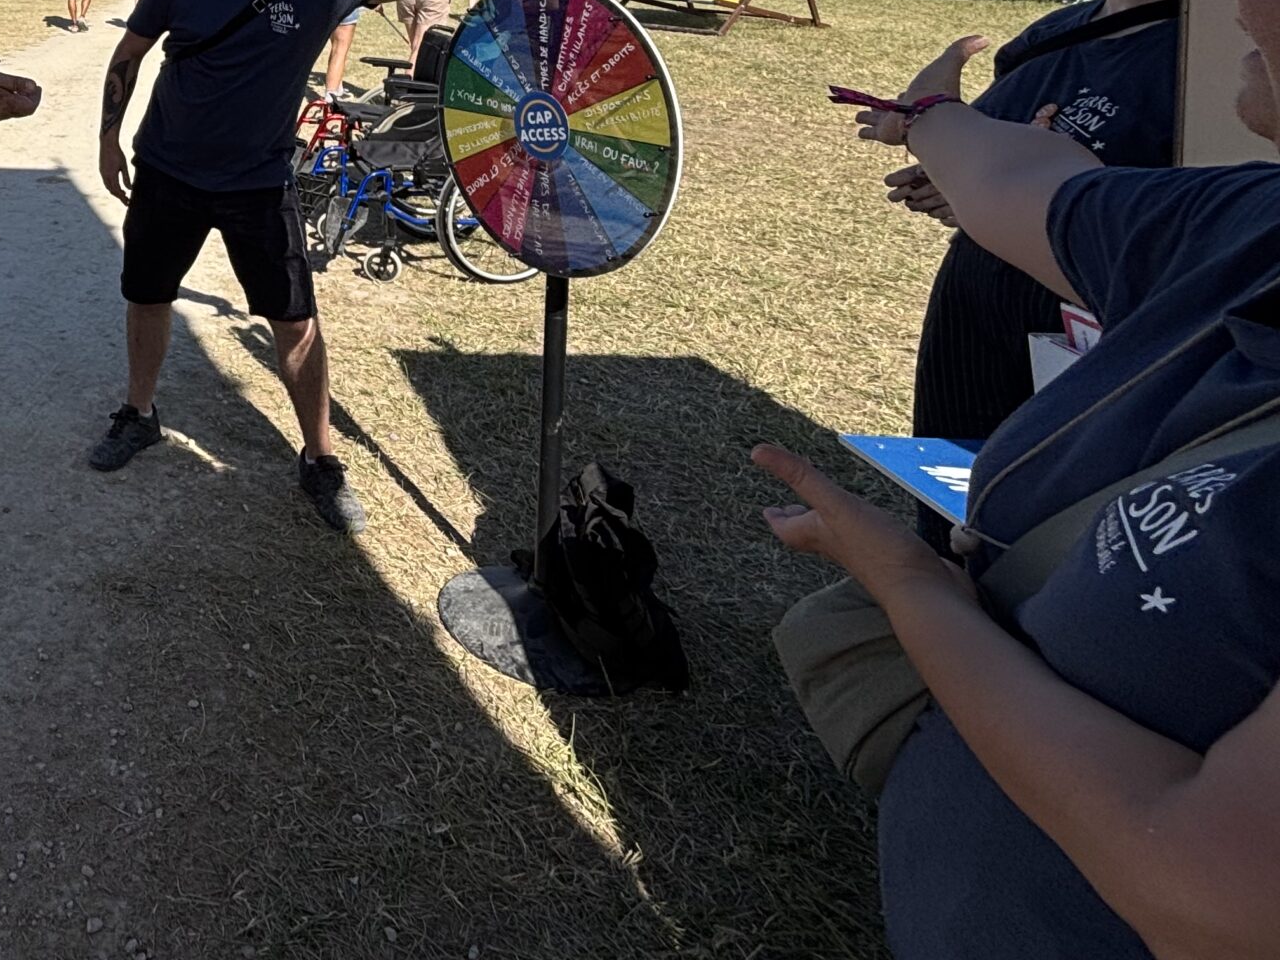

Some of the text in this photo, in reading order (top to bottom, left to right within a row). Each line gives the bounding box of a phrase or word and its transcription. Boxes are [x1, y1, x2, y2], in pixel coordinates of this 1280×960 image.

[277, 12, 294, 25] SON
[556, 16, 574, 73] ATTITUDES
[602, 42, 636, 74] DROITS
[527, 110, 553, 125] CAP
[1068, 107, 1106, 132] SON
[520, 127, 567, 142] ACCESS
[574, 135, 598, 153] VRAI
[602, 146, 619, 161] OU
[620, 153, 650, 171] FAUX
[1128, 484, 1199, 555] SON
